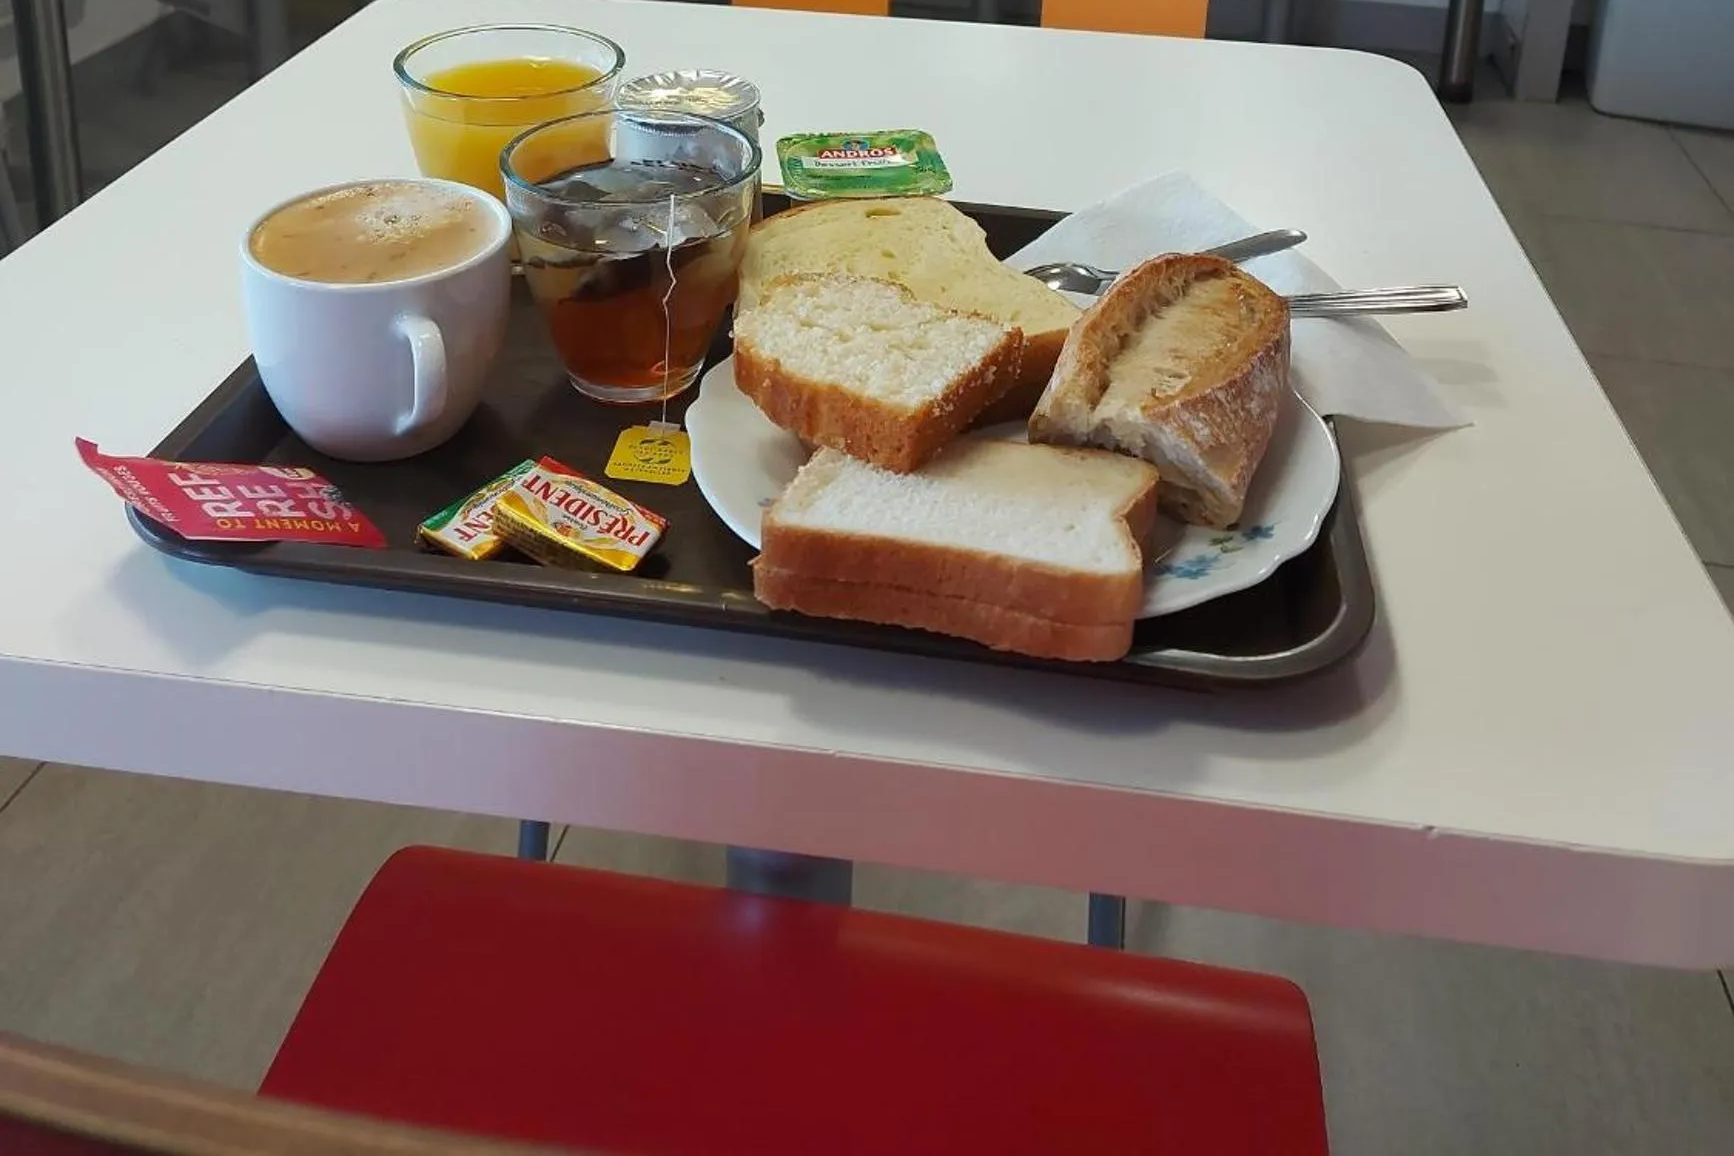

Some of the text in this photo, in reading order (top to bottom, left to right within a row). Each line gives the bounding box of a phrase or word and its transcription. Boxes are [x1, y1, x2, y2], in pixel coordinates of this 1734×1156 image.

[820, 147, 895, 158] ANDROS
[521, 475, 650, 546] PRÉSIDENT
[216, 518, 360, 533] A MOMENT TO
